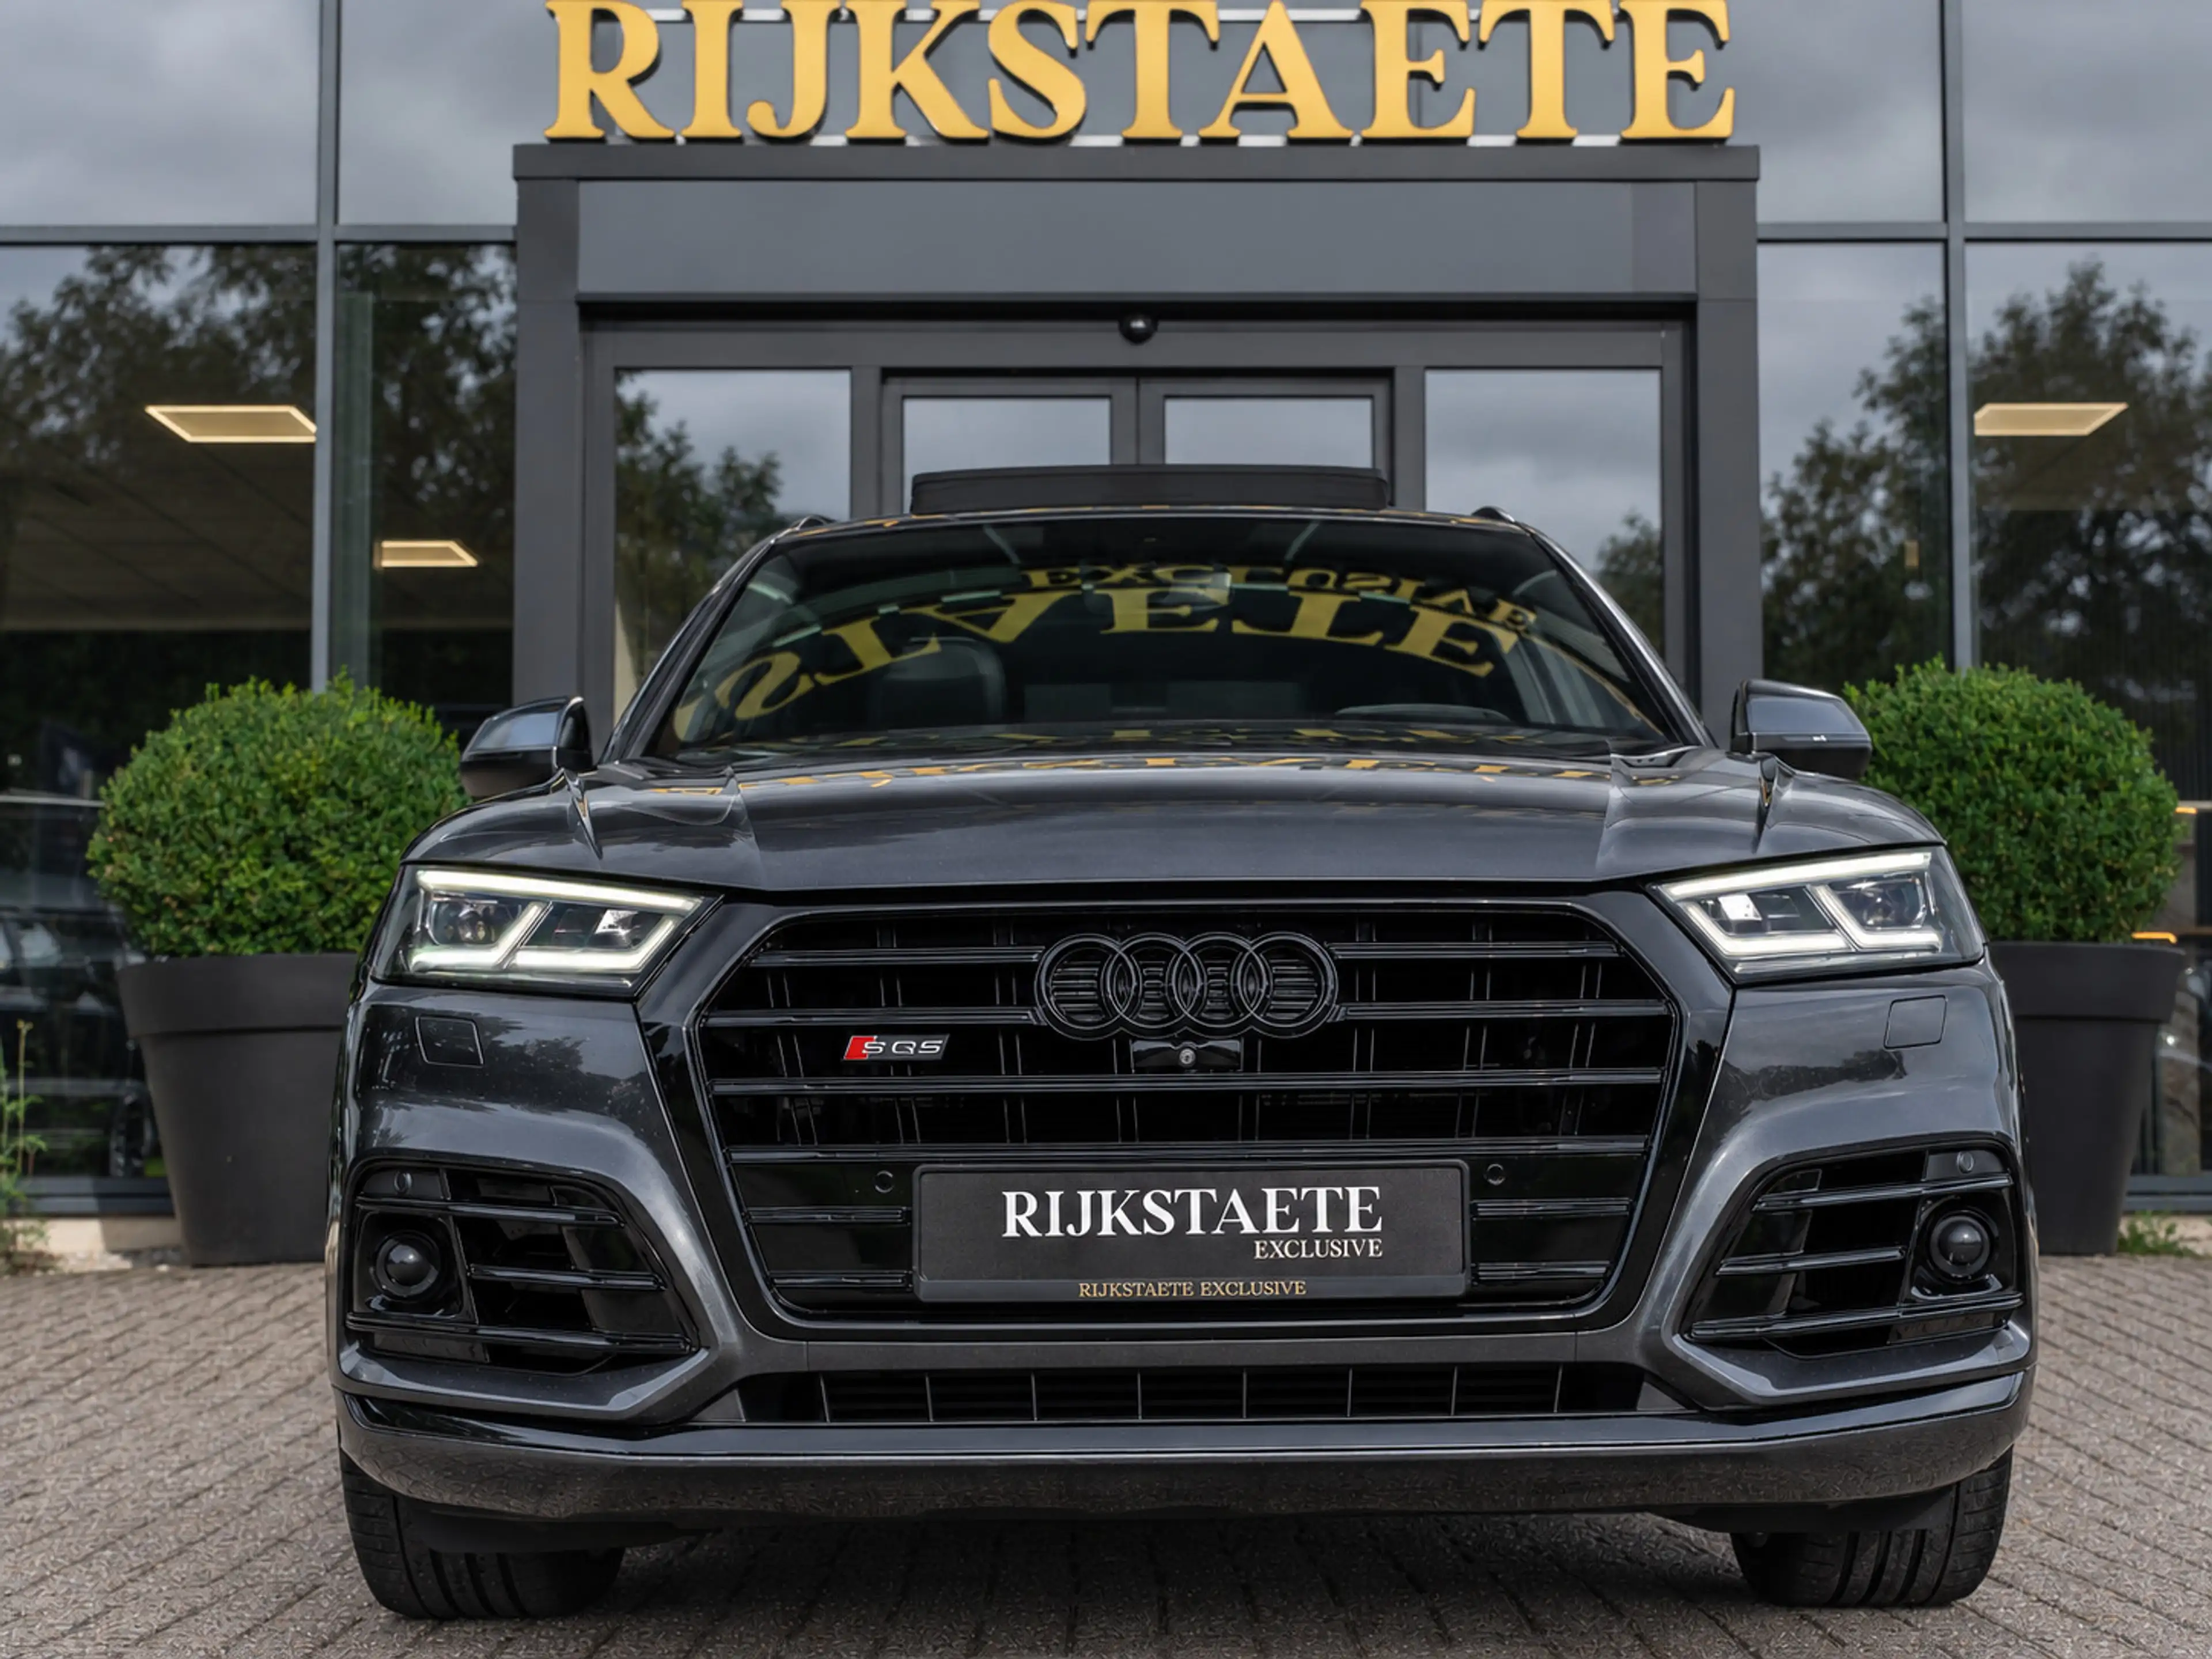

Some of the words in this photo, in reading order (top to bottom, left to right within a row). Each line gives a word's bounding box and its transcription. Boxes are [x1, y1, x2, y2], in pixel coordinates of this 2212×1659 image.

[544, 0, 1735, 140] RIJKSTAETE
[1002, 1186, 1382, 1237] RIJKSTAETE
[1254, 1238, 1382, 1260] EXCLUSIVE
[1078, 1282, 1194, 1298] RIJKSTAETE
[1200, 1280, 1306, 1297] EXCLUSIVE
